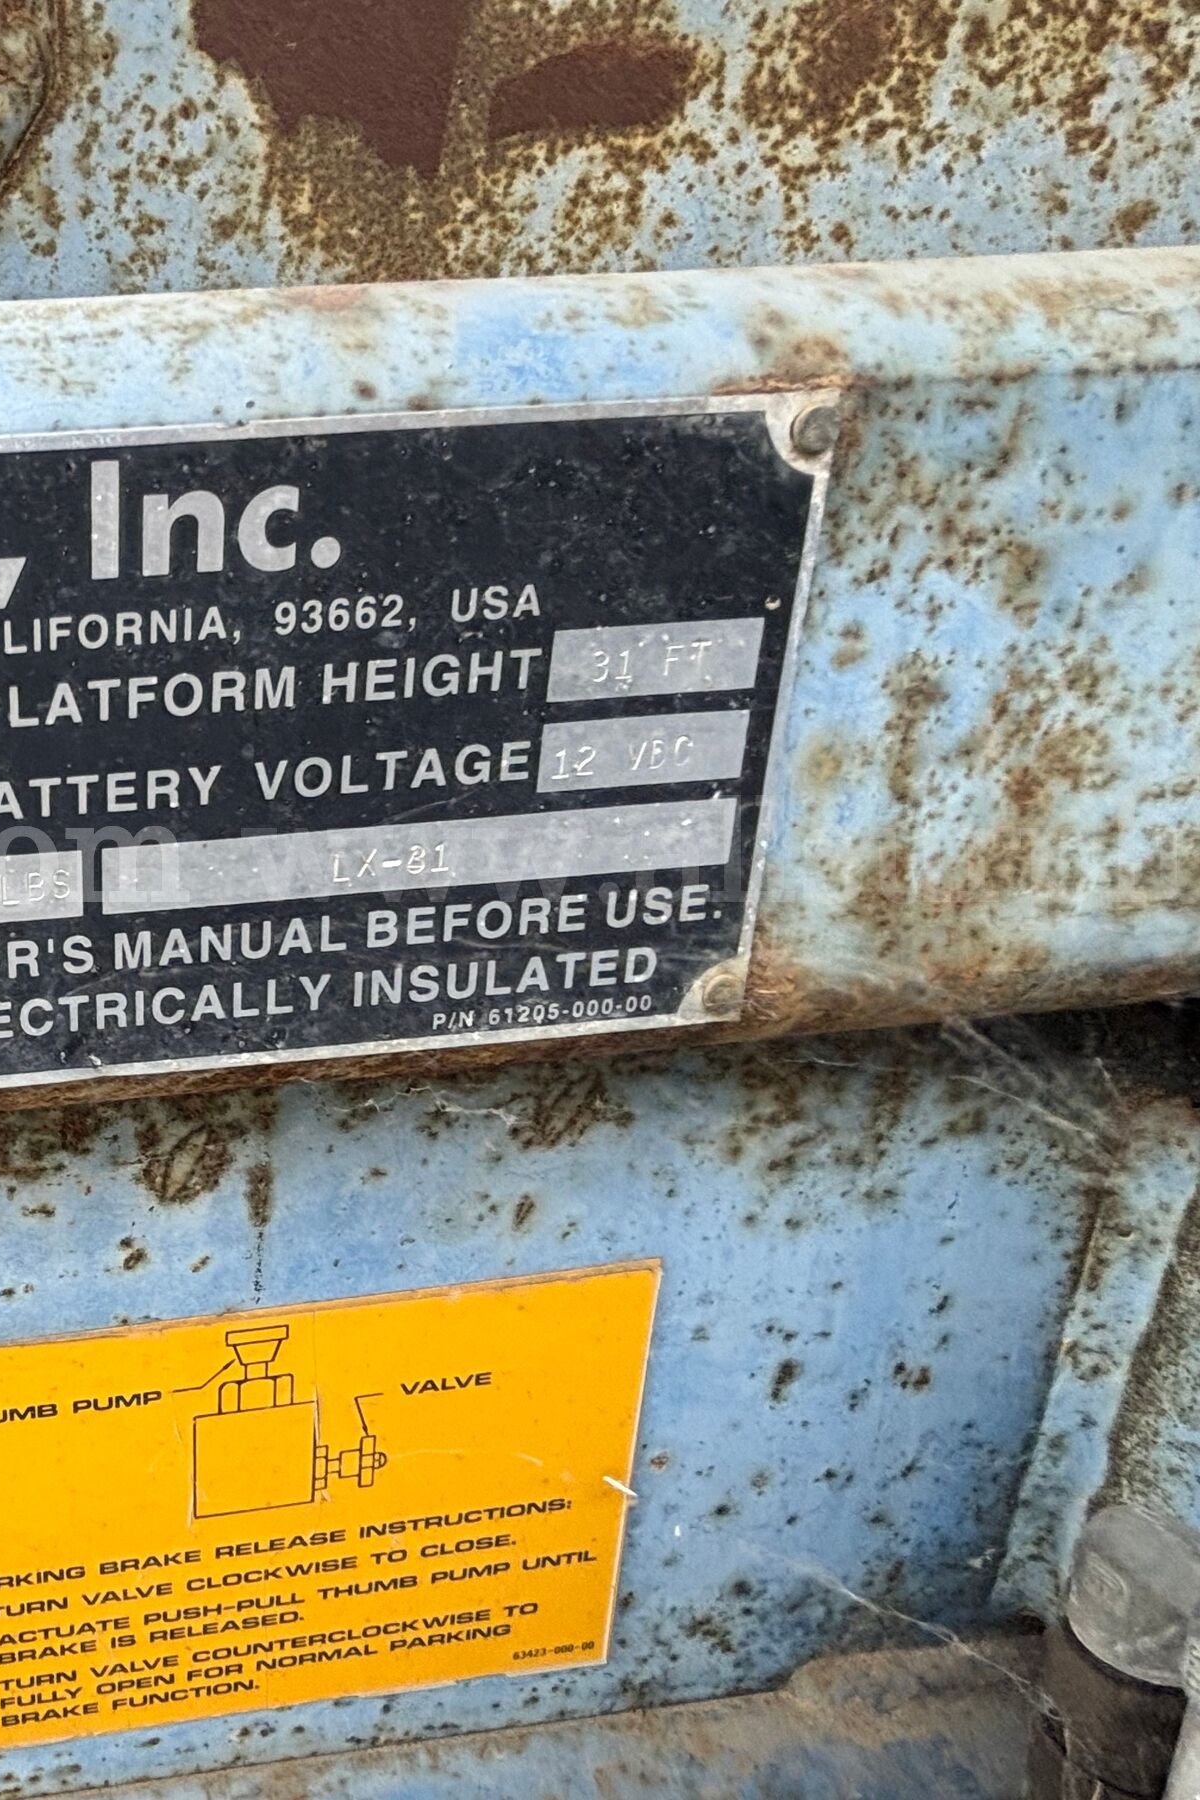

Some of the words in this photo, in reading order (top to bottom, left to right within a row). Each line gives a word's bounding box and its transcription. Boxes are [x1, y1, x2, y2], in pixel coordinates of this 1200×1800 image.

[91, 460, 341, 579] Inc.
[275, 593, 418, 637] 93662,
[451, 583, 542, 623] USA
[322, 647, 542, 705] HEIGHT
[591, 648, 633, 683] 31
[663, 640, 713, 677] FT
[255, 740, 532, 801] VOLTAGE
[551, 745, 597, 781] 12
[0, 868, 72, 907] LBS
[115, 914, 348, 971] MANUAL
[367, 893, 587, 950] BEFORE
[606, 883, 723, 930] USE.
[354, 946, 659, 1009] INSULATED
[432, 1009, 475, 1031] P/N
[487, 993, 653, 1026] 61205-000-00
[72, 1389, 163, 1417] PUMP
[400, 1371, 493, 1397] VALVE
[99, 1549, 202, 1576] BRAKE
[215, 1528, 347, 1560] RELEASE
[359, 1497, 574, 1540] INSTRUCTIONS:
[81, 1581, 174, 1607] VALVE
[186, 1555, 359, 1592] CLOCKWISE
[370, 1548, 409, 1566] TO
[420, 1533, 518, 1559] CLOSE.
[143, 1591, 306, 1627] PUSH-PULL
[317, 1575, 419, 1602] THUMB
[430, 1561, 512, 1586] PUMP
[522, 1549, 598, 1572] UNTIL
[90, 1654, 180, 1679] VALVE
[191, 1608, 492, 1664] COUNTERCLOCKWISE
[504, 1601, 540, 1618] TO
[110, 1634, 137, 1650] IS
[149, 1610, 305, 1644] RELEASED.
[0, 1685, 84, 1710] FULLY
[96, 1672, 176, 1695] OPEN
[186, 1662, 244, 1682] FOR
[256, 1643, 379, 1673] NORMAL
[389, 1623, 512, 1653] PARKING
[1, 1701, 99, 1728] BRAKE
[111, 1679, 261, 1711] FUNCTION.
